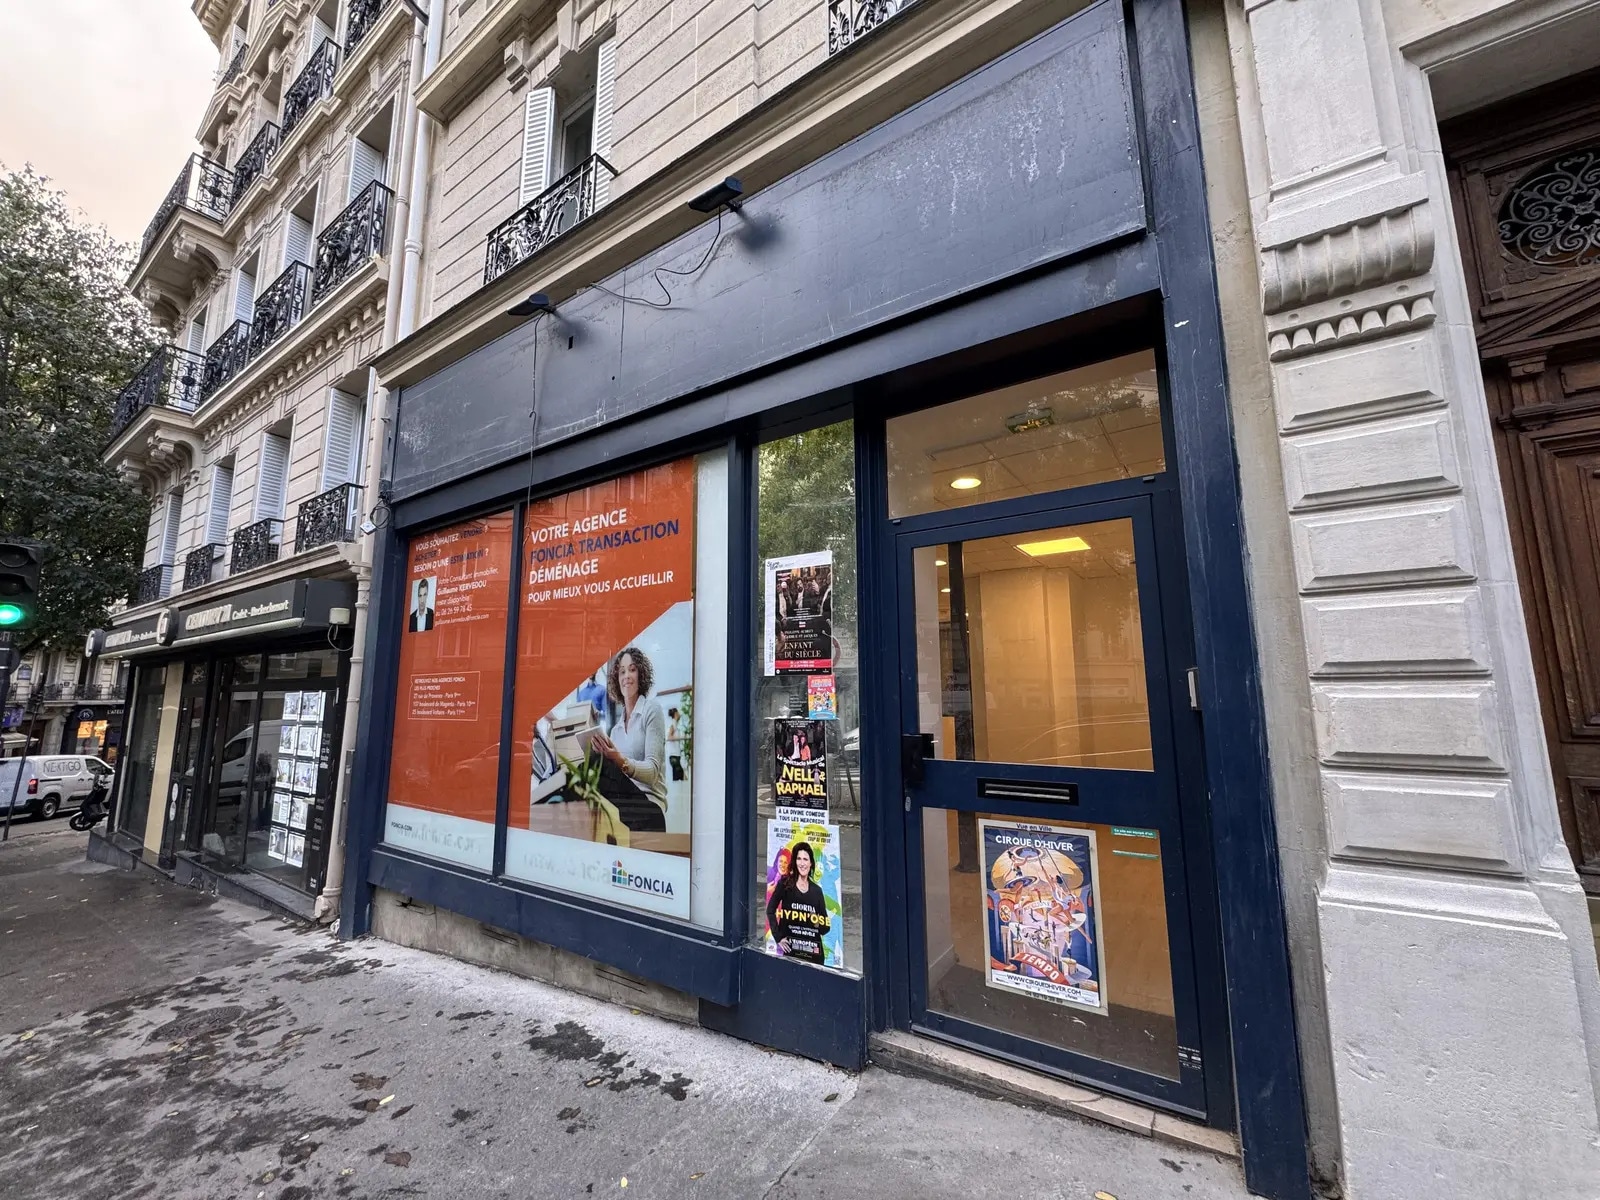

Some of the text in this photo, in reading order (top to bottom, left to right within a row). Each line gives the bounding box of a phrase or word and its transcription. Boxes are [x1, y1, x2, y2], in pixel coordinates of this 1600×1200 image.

[532, 508, 627, 544] VOTRE AGENCE
[415, 541, 429, 551] VOUS
[430, 533, 459, 548] SOUHAITEZ
[530, 519, 679, 564] FONCIA TRANSACTION
[414, 548, 489, 572] BESOIN D'UNE ESTIMATION ?
[529, 559, 599, 584] DÉMÉNAGE
[437, 580, 487, 595] Guillaume KERVEDOU
[528, 571, 674, 603] POUR MIEUX VOUS ACCUEILLIR
[784, 642, 813, 650] ENFANT
[796, 649, 821, 658] SIÈCLE
[782, 764, 826, 782] NELL &
[776, 782, 826, 796] RAPHAEL
[996, 836, 1074, 852] CIRQUE D'HIVER
[628, 874, 674, 896] FONCIA
[791, 903, 816, 913] GIORDA
[776, 908, 831, 927] HYPN'OSE
[1022, 953, 1060, 981] TEMPO
